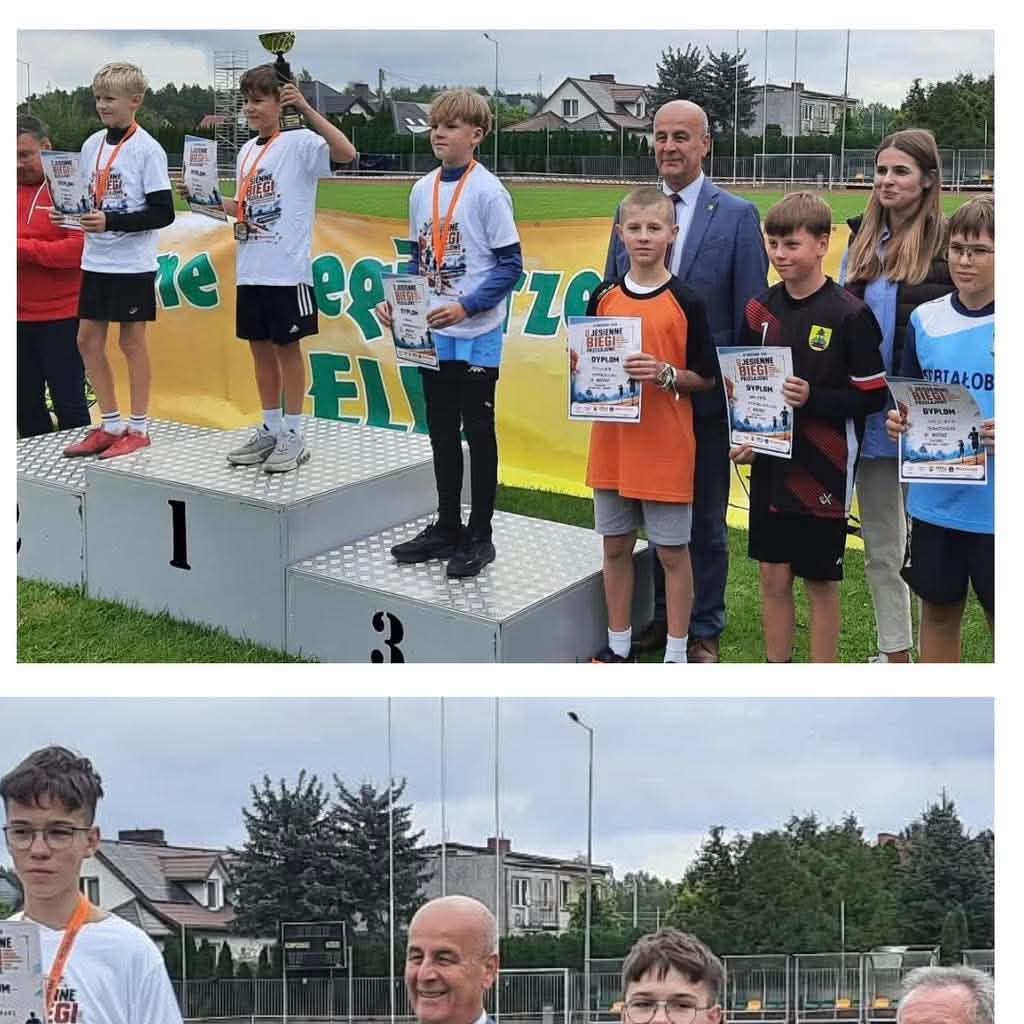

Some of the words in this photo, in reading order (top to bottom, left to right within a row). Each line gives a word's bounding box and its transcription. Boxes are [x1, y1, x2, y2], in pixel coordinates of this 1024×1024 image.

[590, 328, 623, 337] JESIENNE
[586, 335, 616, 348] BIEGI
[591, 355, 620, 363] DYPLOM
[741, 357, 773, 366] JESIENNE
[738, 365, 768, 376] BIEGI
[745, 384, 773, 392] DYPLOM
[912, 391, 946, 402] BIEGI
[922, 407, 956, 416] DYPLOM
[168, 499, 191, 571] 1
[371, 611, 406, 664] 3
